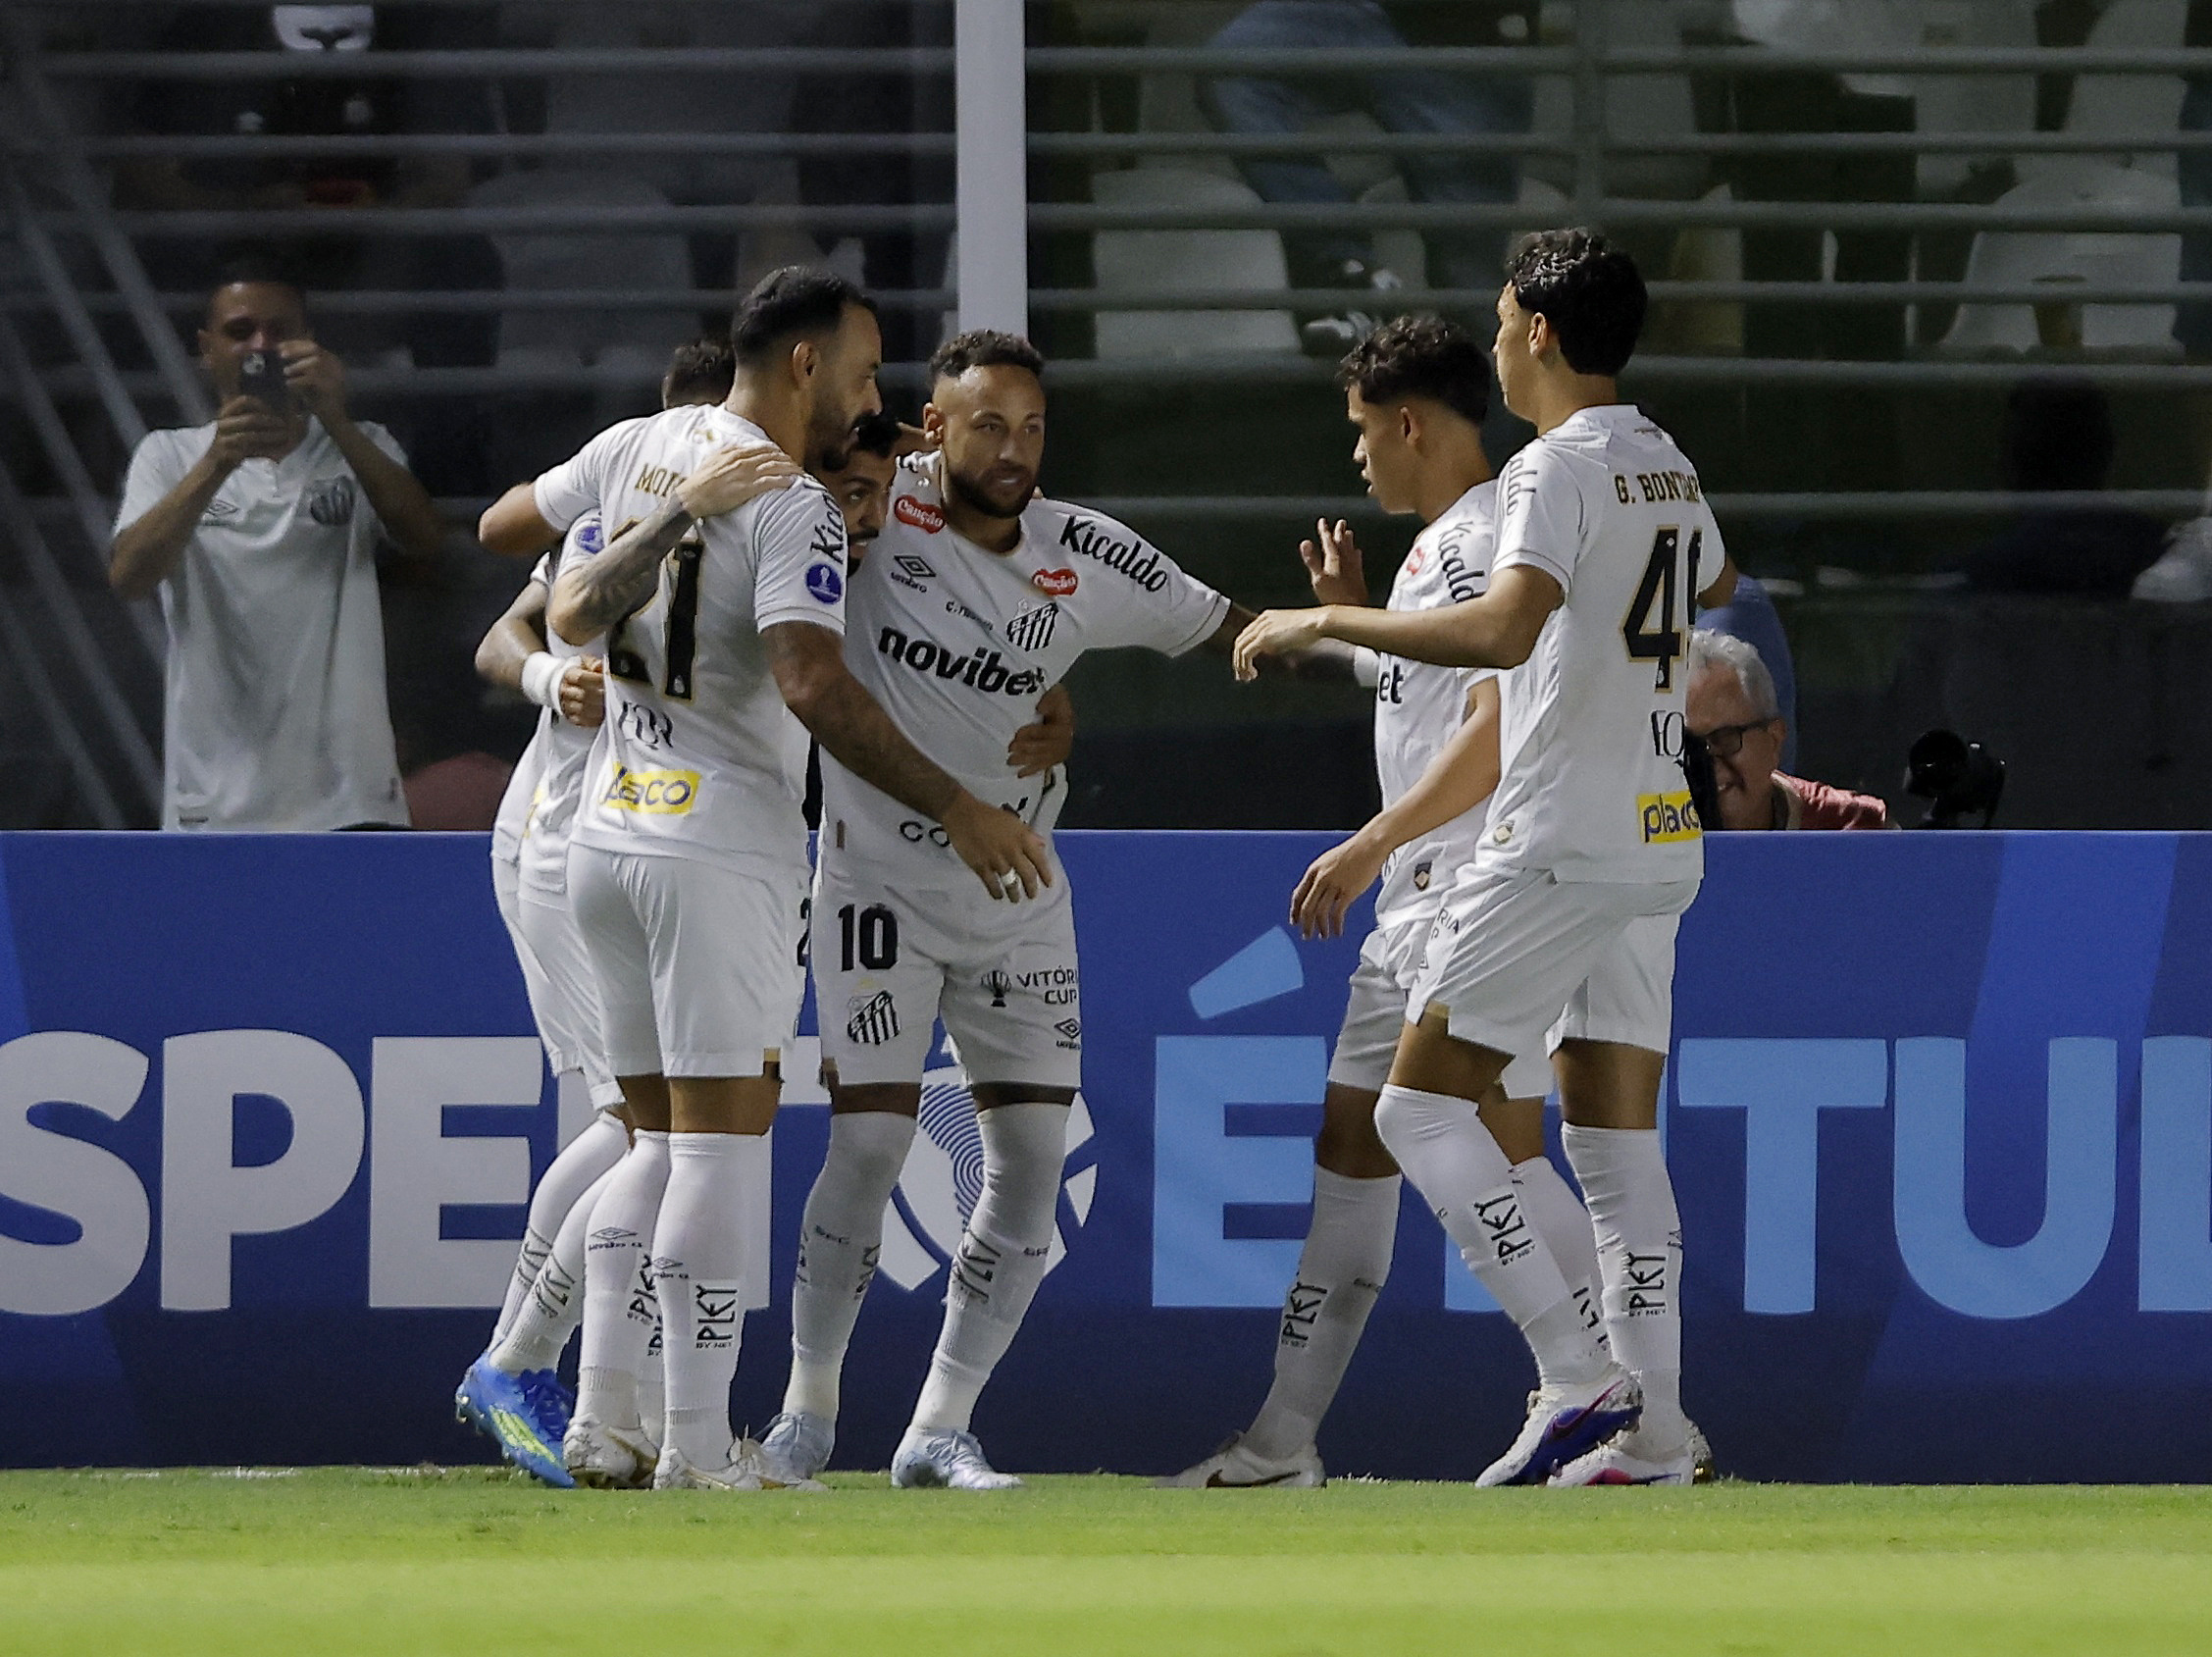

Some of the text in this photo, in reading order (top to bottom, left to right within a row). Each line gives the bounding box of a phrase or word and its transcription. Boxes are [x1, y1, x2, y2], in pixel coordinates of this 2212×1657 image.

[1059, 515, 1167, 593] Kicaldo
[838, 902, 899, 972] 10
[1016, 964, 1079, 988] VITÓRI
[1044, 988, 1077, 1006] CUP
